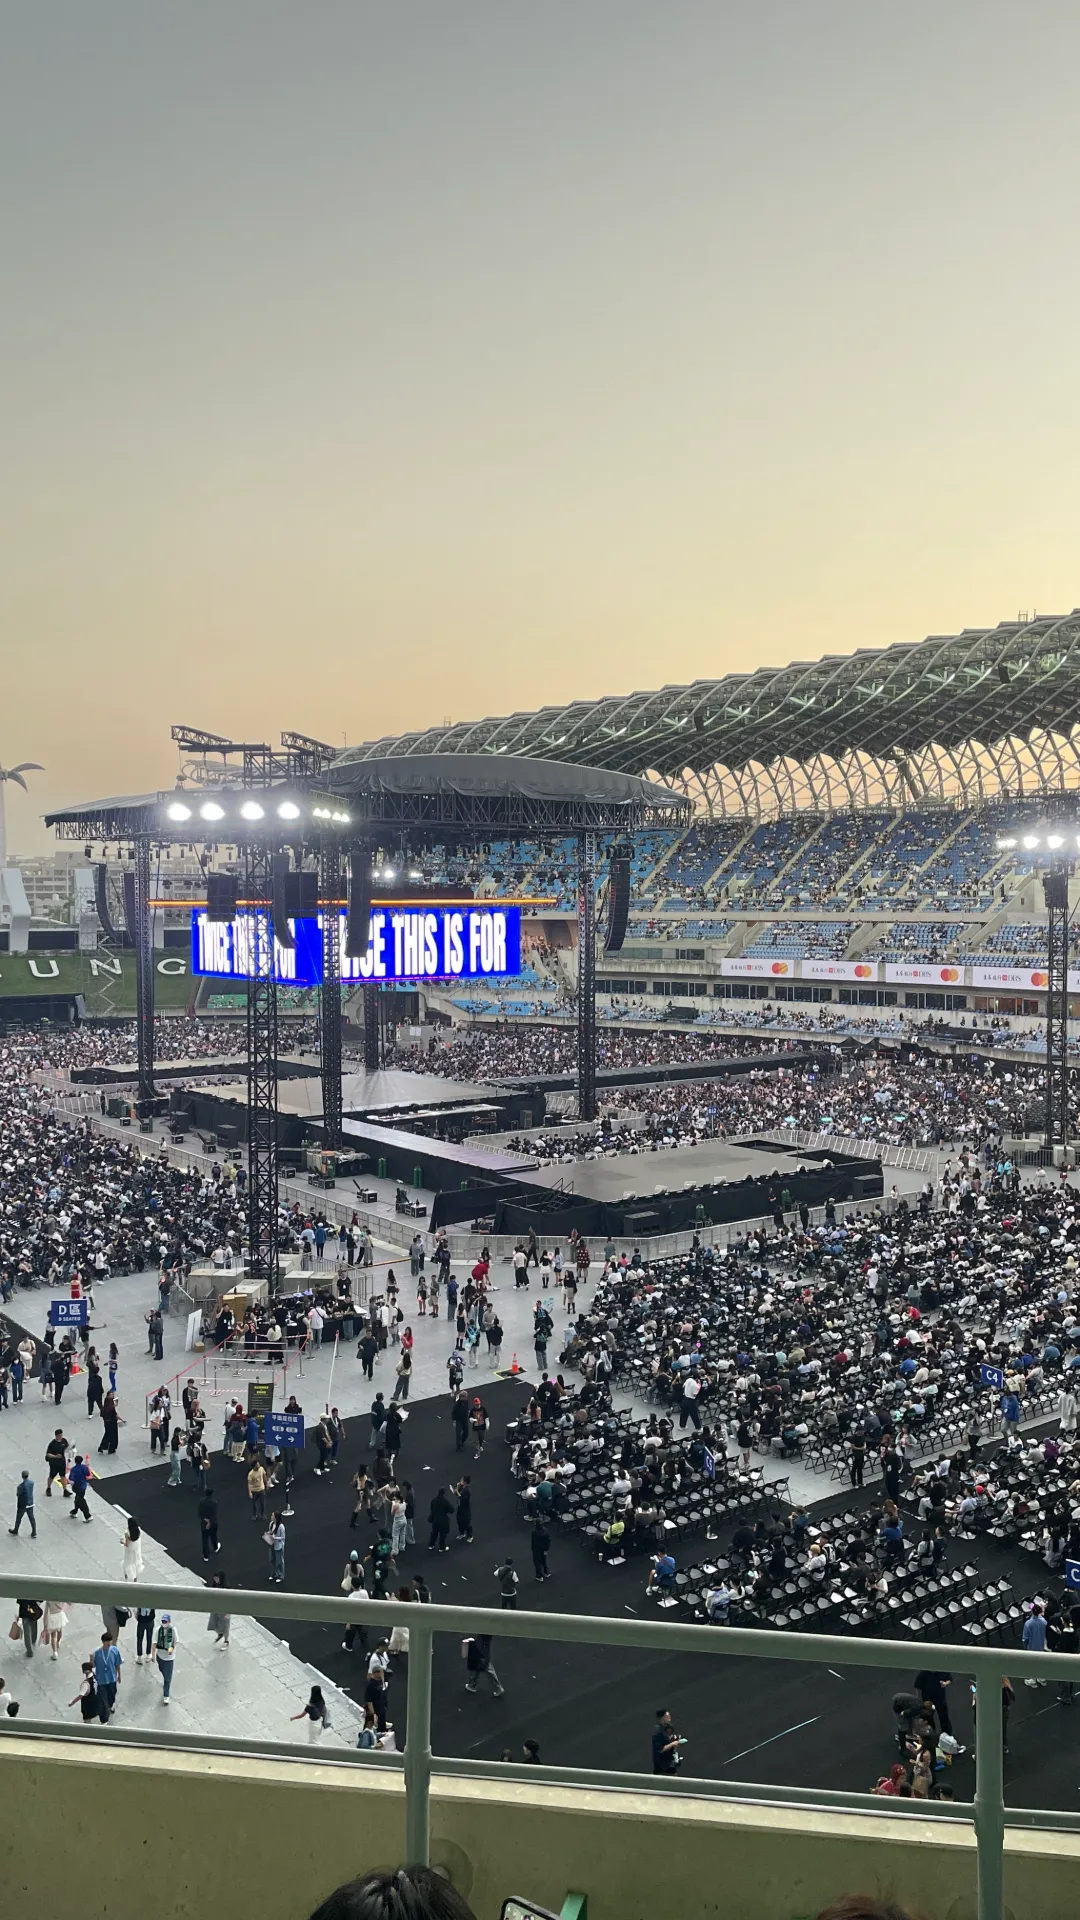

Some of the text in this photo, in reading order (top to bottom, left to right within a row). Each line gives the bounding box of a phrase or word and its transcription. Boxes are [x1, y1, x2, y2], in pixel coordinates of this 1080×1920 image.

[987, 797, 1004, 805] C17
[392, 913, 438, 976] THIS
[444, 912, 464, 974] IS
[469, 912, 507, 973] FOR
[986, 1370, 998, 1383] C4
